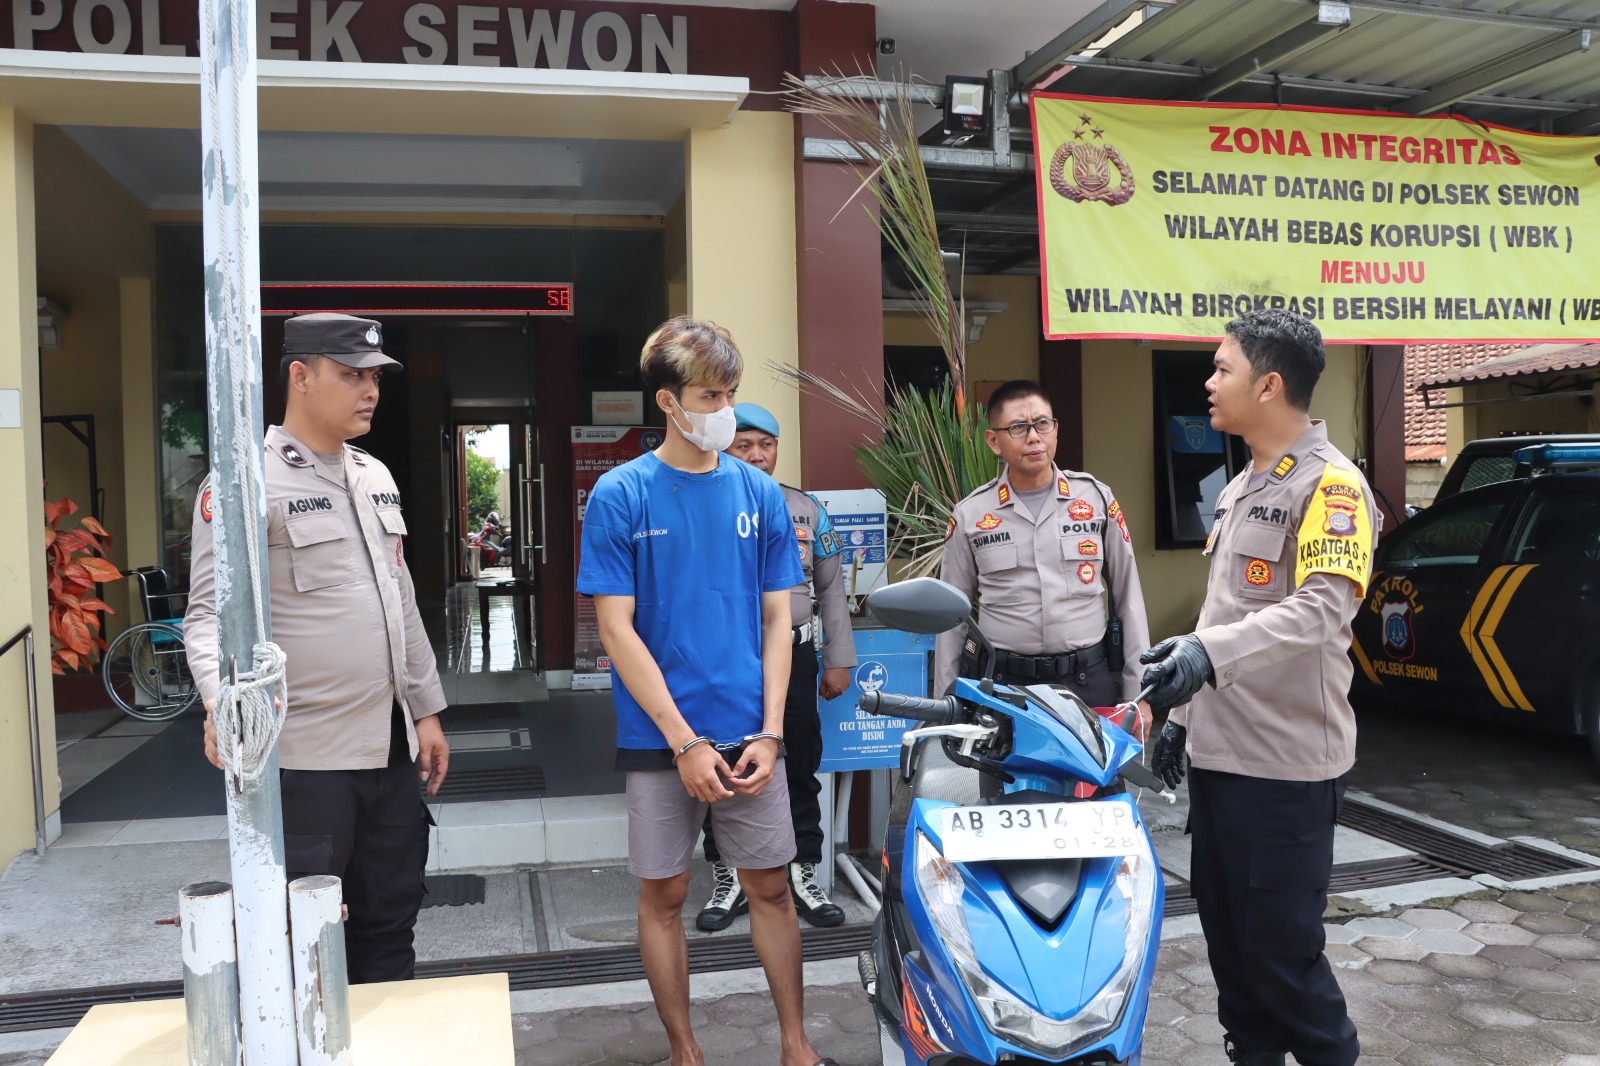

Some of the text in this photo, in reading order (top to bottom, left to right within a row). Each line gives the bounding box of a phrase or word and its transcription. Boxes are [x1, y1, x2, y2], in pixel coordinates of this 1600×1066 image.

[12, 0, 688, 74] POLEK SEWON
[1208, 126, 1522, 166] ZONA INTEGRITAS
[1152, 170, 1580, 206] SELAMAT DATANG DI POLSEK SEWON
[1164, 214, 1279, 243] WILAYAH
[1287, 219, 1364, 247] BEBAS
[1370, 223, 1481, 249] KORUPSI
[1504, 225, 1559, 248] WBK
[1320, 260, 1426, 285] MENUJU
[1065, 288, 1182, 317] WILAYAH
[1333, 296, 1427, 320] BERSIH
[1434, 296, 1551, 321] MELAYANI
[288, 497, 332, 515] AGUNG
[1248, 505, 1288, 524] POLRI
[974, 531, 1011, 548] SUMANTA
[1063, 522, 1100, 534] POLRI
[1300, 538, 1359, 563] KASATGAS
[1370, 576, 1424, 615] PATROLI
[1373, 660, 1437, 681] POLSEK SEWON
[840, 719, 906, 731] CUCI TANGAN ANDA
[862, 731, 884, 740] DISINI
[951, 807, 1125, 832] AB 3314 YP
[925, 982, 955, 1041] HONDA
